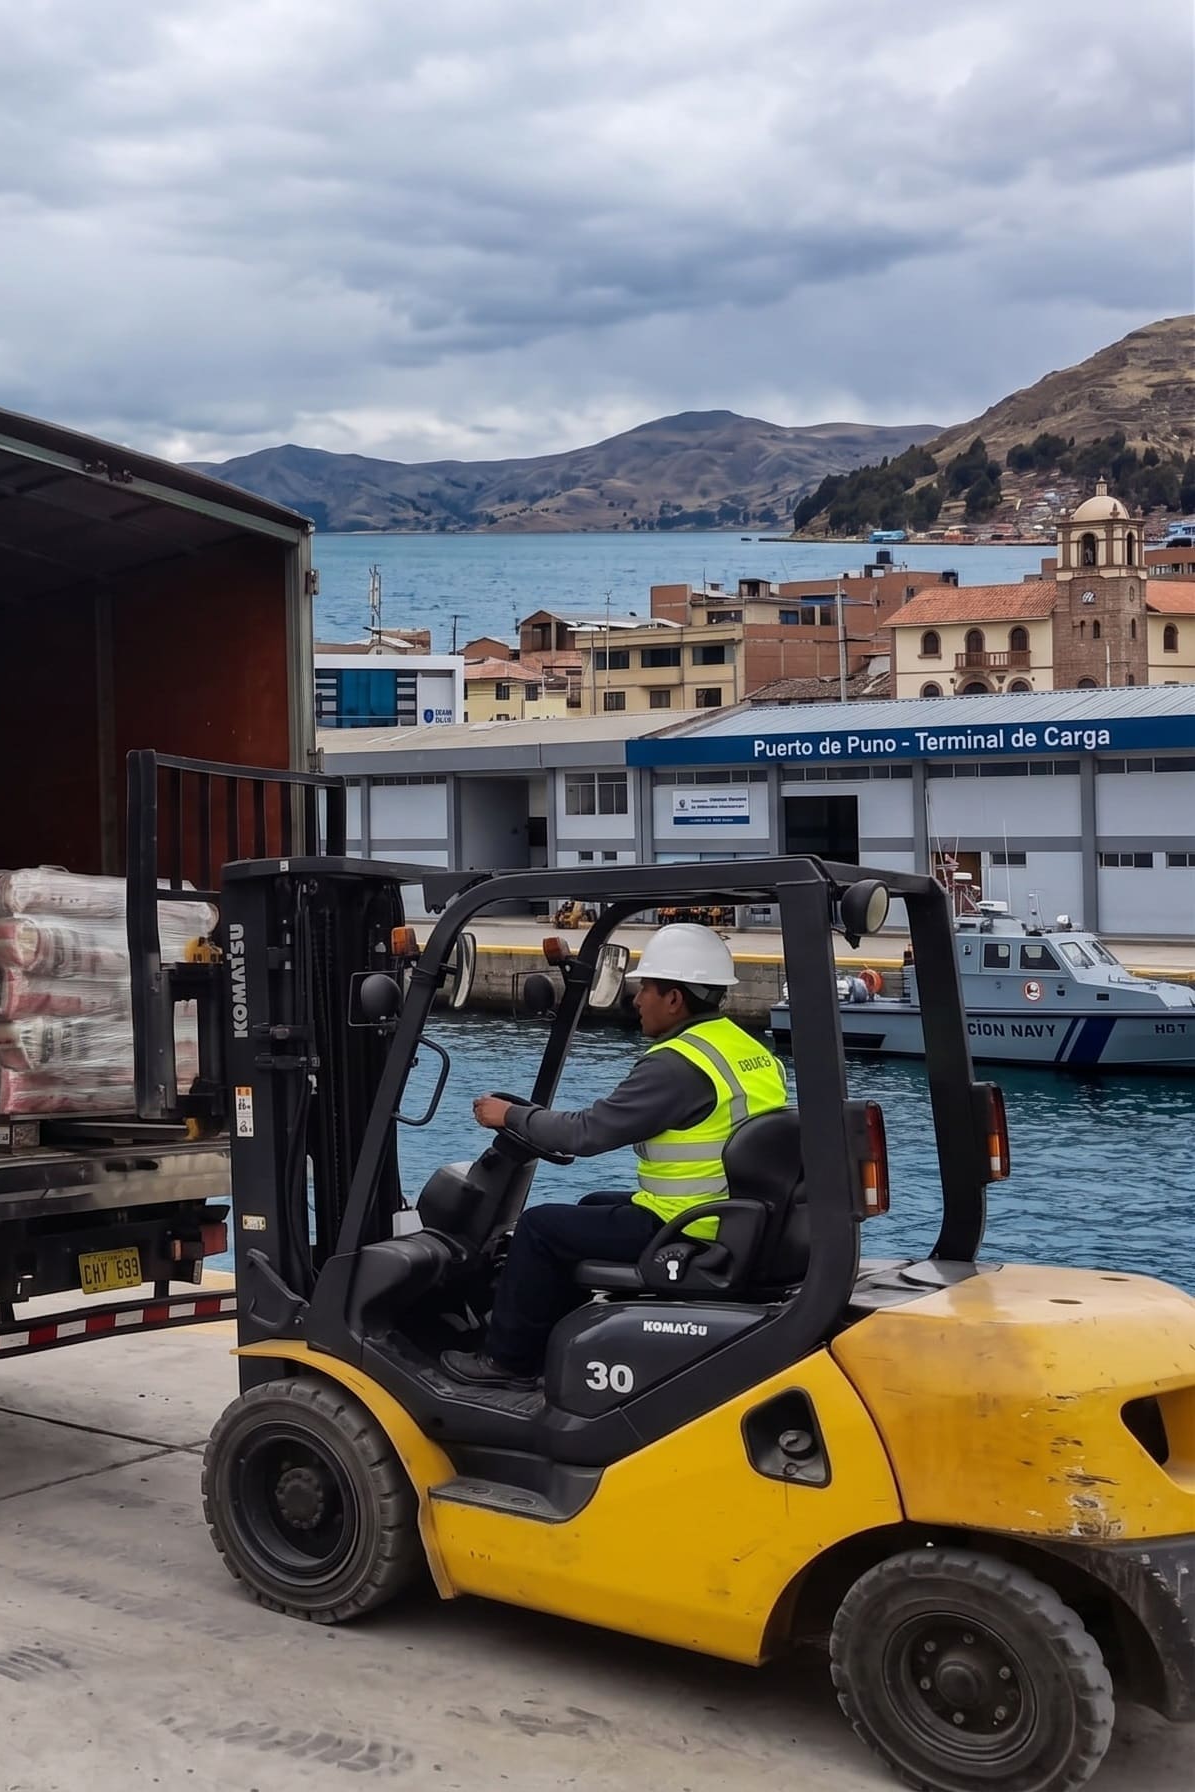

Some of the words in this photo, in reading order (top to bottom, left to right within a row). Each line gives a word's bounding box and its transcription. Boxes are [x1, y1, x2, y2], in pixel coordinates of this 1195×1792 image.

[754, 740, 813, 757] Puerto
[819, 737, 842, 754] de
[847, 736, 897, 754] Puno
[914, 729, 1004, 751] Terminal
[1011, 728, 1038, 748] de
[1044, 726, 1111, 750] Carga
[226, 923, 248, 1038] KOMATSU
[1011, 1023, 1056, 1038] NAVY
[116, 1257, 139, 1279] 699
[643, 1320, 708, 1336] KOMATSU
[585, 1361, 634, 1394] 30
